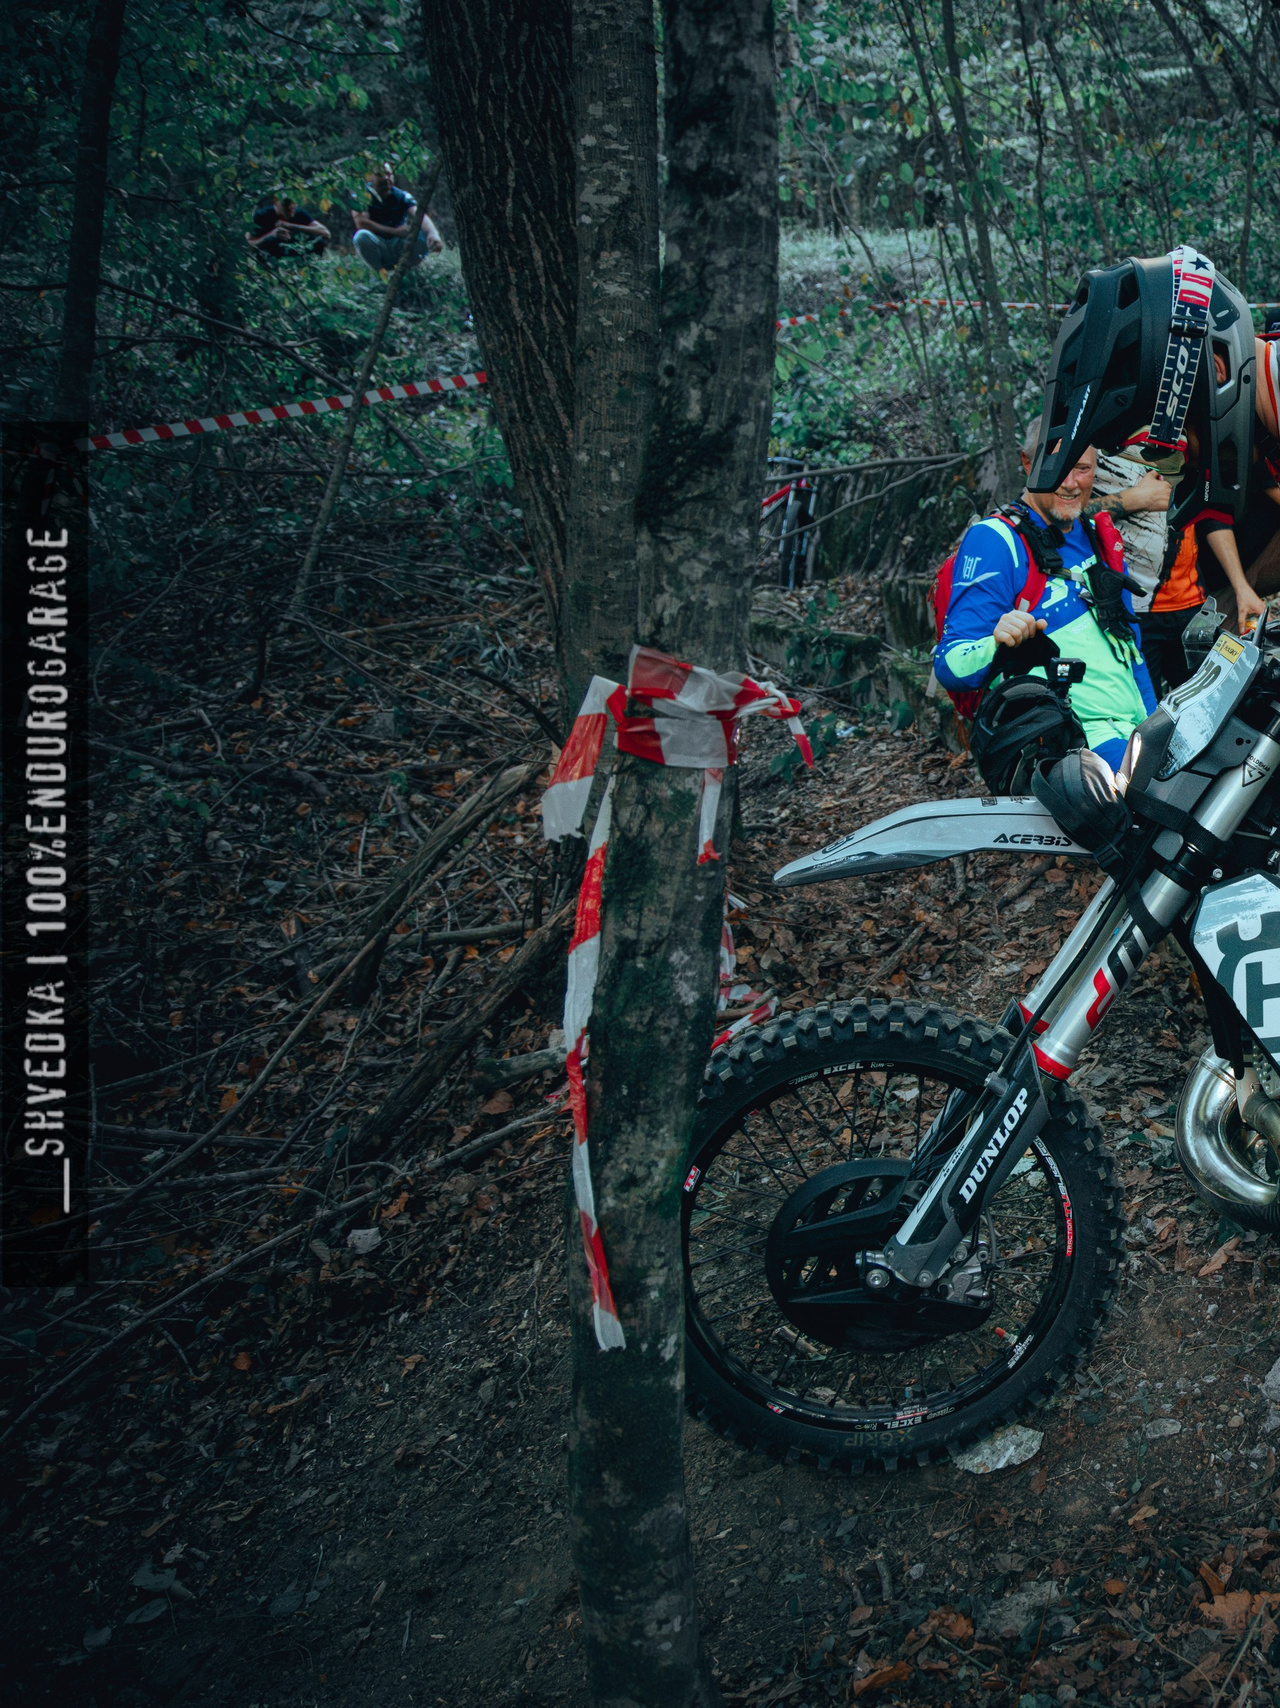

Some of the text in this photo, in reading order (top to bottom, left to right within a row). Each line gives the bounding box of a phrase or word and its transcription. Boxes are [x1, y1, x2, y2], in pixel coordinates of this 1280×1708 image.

[993, 833, 1073, 847] ACERBIS
[823, 1064, 864, 1075] EXCEL
[959, 1087, 1028, 1204] DUNLOP
[884, 1416, 923, 1430] EXCEL
